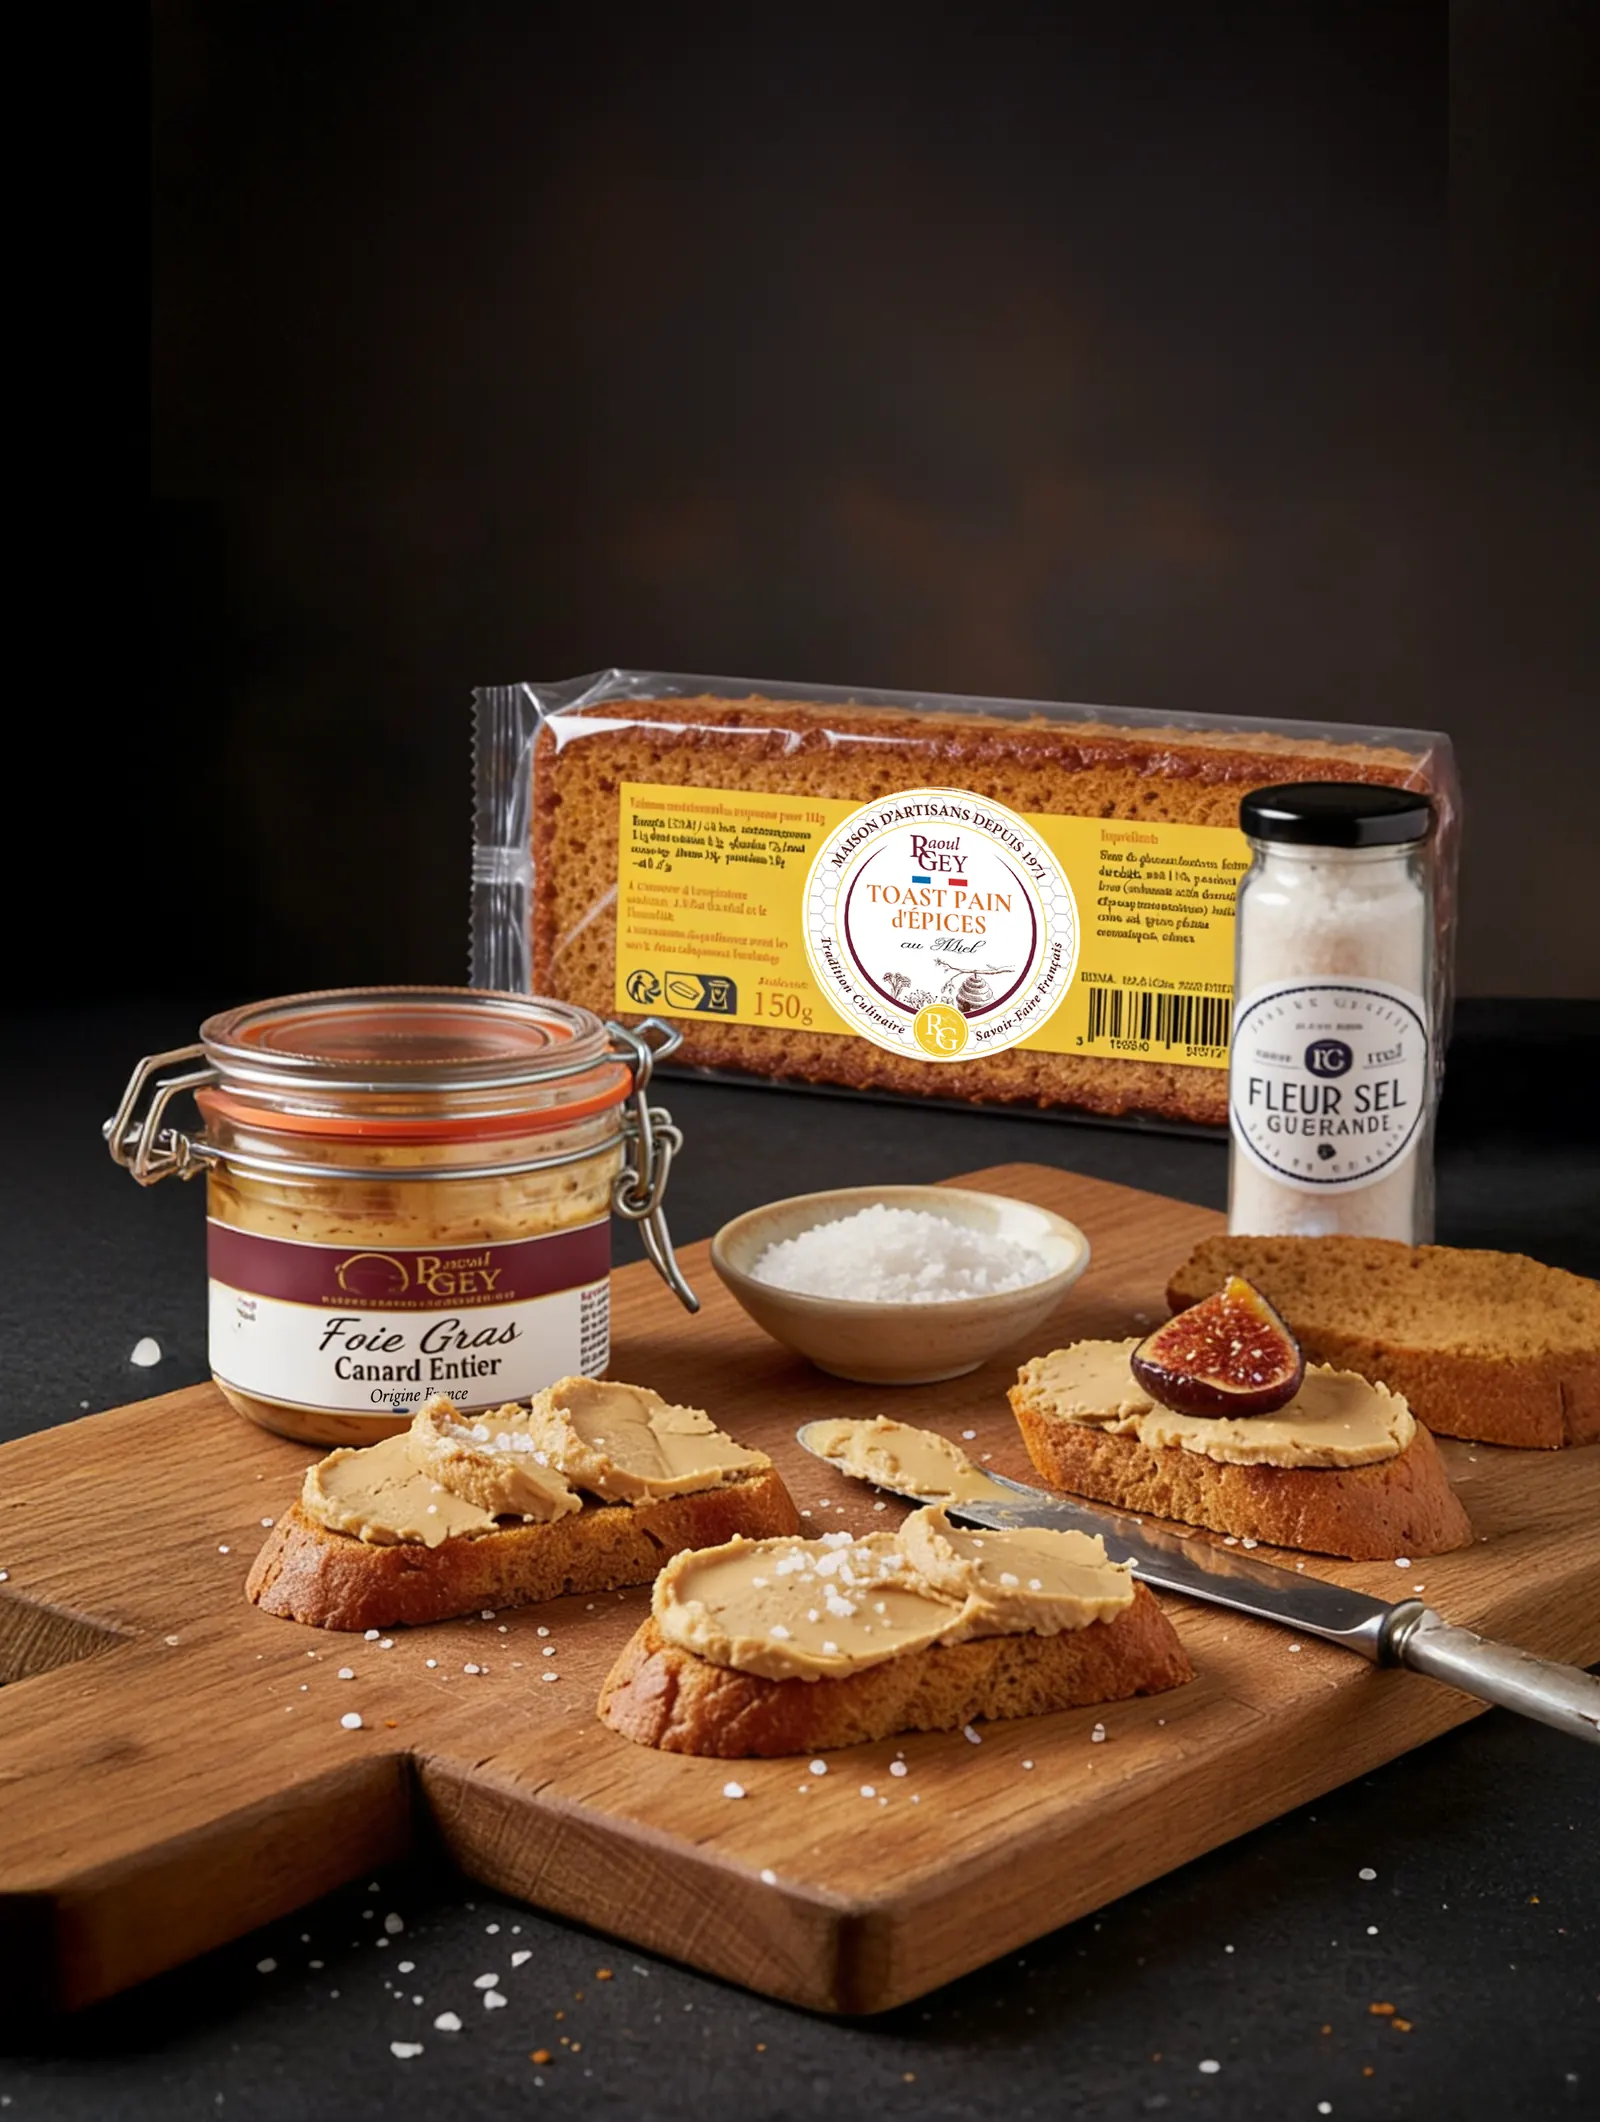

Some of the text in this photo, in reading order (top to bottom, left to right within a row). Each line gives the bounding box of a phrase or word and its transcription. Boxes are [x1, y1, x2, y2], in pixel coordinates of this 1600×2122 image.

[831, 818, 879, 869] MAISON
[973, 813, 1025, 852] DEPUIS
[1021, 848, 1047, 880] 1971
[910, 834, 960, 858] Raoul
[918, 850, 968, 873] GEY
[867, 884, 1012, 912] TOAST PAIN
[892, 907, 986, 934] d'ÉPICES
[900, 937, 986, 954] au Miel
[821, 937, 906, 1035] Tradition Culinaire
[975, 941, 1063, 1041] Savoir-Faire Français
[753, 991, 813, 1026] 150g
[1249, 1077, 1407, 1116] FLEUR SEL
[427, 1268, 502, 1296] GEY
[318, 1317, 523, 1355] Foie Gras
[335, 1354, 502, 1382] Canard Entier
[370, 1387, 469, 1406] Origine Fnce
